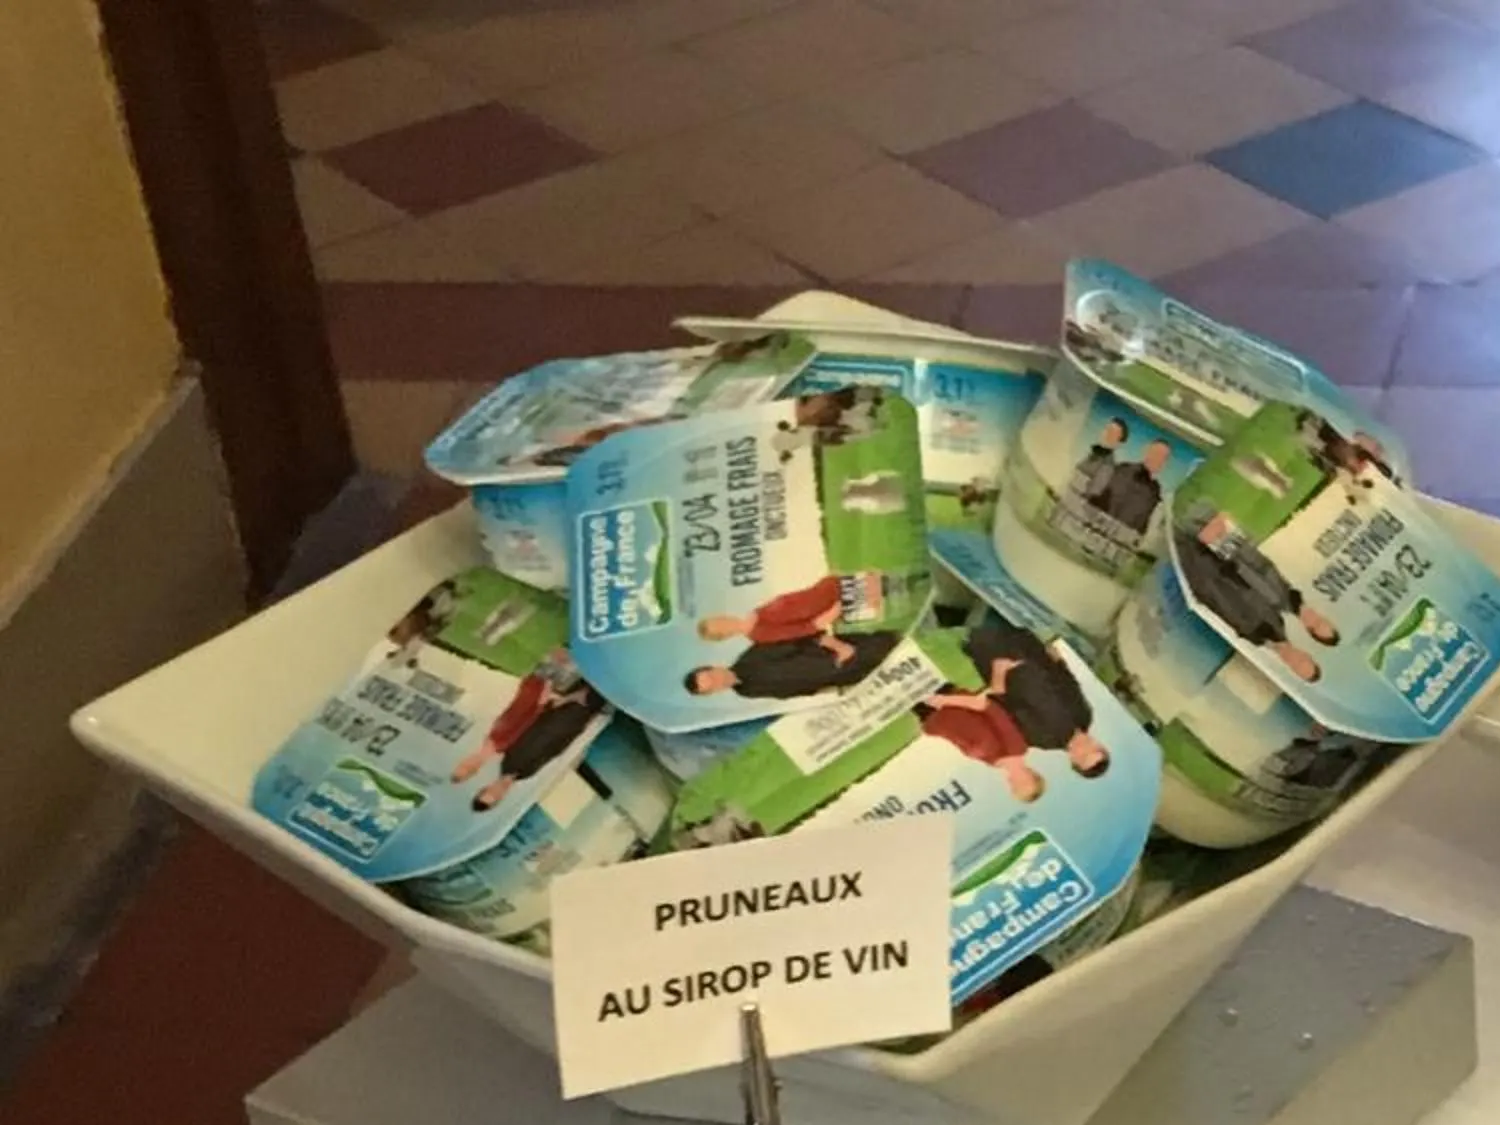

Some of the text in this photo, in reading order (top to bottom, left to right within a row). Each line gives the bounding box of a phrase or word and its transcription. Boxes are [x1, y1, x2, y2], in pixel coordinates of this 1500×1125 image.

[613, 510, 637, 587] France
[726, 436, 763, 587] FROMAGE FRAIS
[589, 516, 614, 633] Campagne
[655, 871, 863, 931] PRUNEAUX
[952, 888, 1022, 943] Fran
[952, 880, 1085, 976] Campagn
[598, 940, 909, 1022] AU SIROP DE VIN
